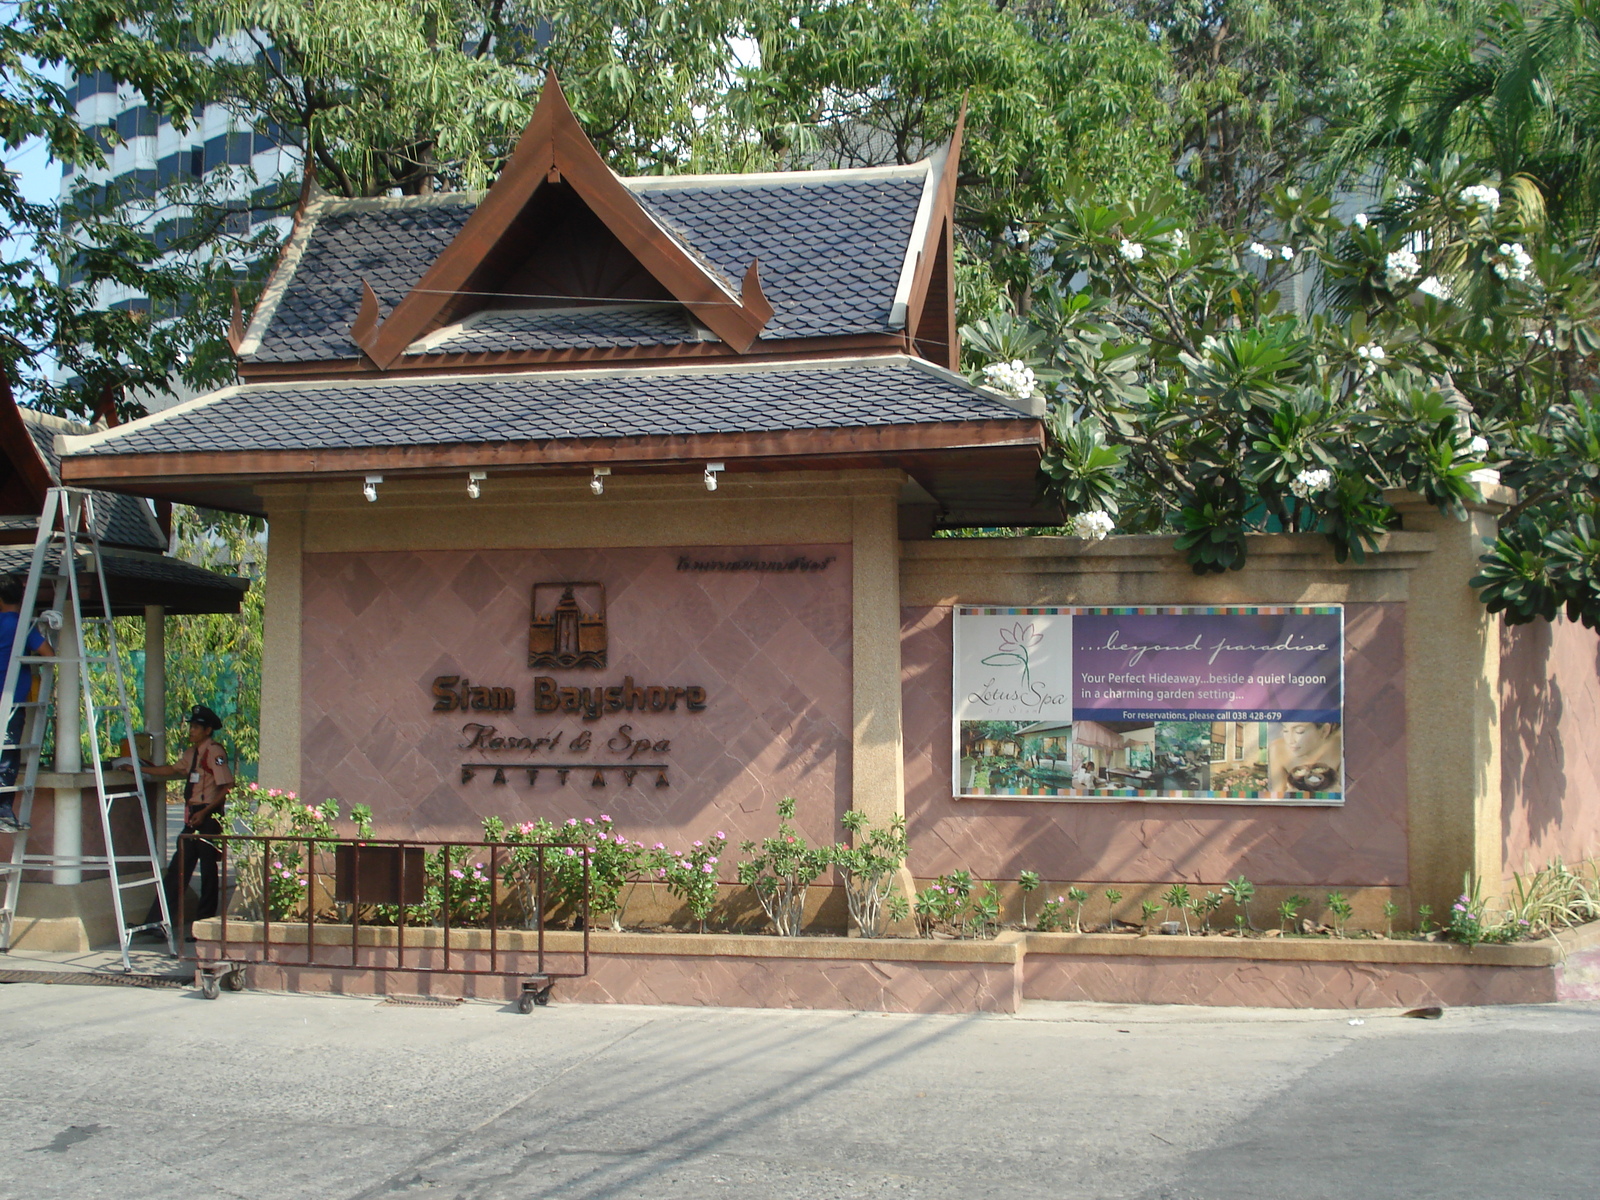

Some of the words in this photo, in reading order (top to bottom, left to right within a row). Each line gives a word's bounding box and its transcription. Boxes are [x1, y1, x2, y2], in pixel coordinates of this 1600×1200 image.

[1208, 633, 1329, 666] paradise
[1081, 672, 1106, 684] Your
[1108, 672, 1146, 684] Perfect
[1247, 675, 1254, 684] a
[1256, 673, 1286, 687] quiet
[1288, 673, 1327, 687] lagoon
[432, 675, 516, 712] Siam
[534, 675, 707, 722] Bayshore
[967, 677, 1020, 707] Lotus
[1020, 681, 1068, 714] Spa
[1081, 688, 1092, 699] in
[1094, 690, 1101, 699] a
[1103, 688, 1154, 702] charming
[1156, 688, 1195, 702] garden
[1197, 688, 1245, 702] setting...
[1122, 711, 1136, 719] For
[1137, 711, 1188, 720] reservations,
[1189, 711, 1215, 721] please
[1216, 711, 1231, 720] call
[1232, 712, 1247, 720] 038
[1249, 712, 1282, 720] 428-679
[458, 722, 564, 754] Resort
[568, 730, 593, 753] &
[607, 724, 671, 761] Spa
[461, 768, 671, 788] PATTAYA
